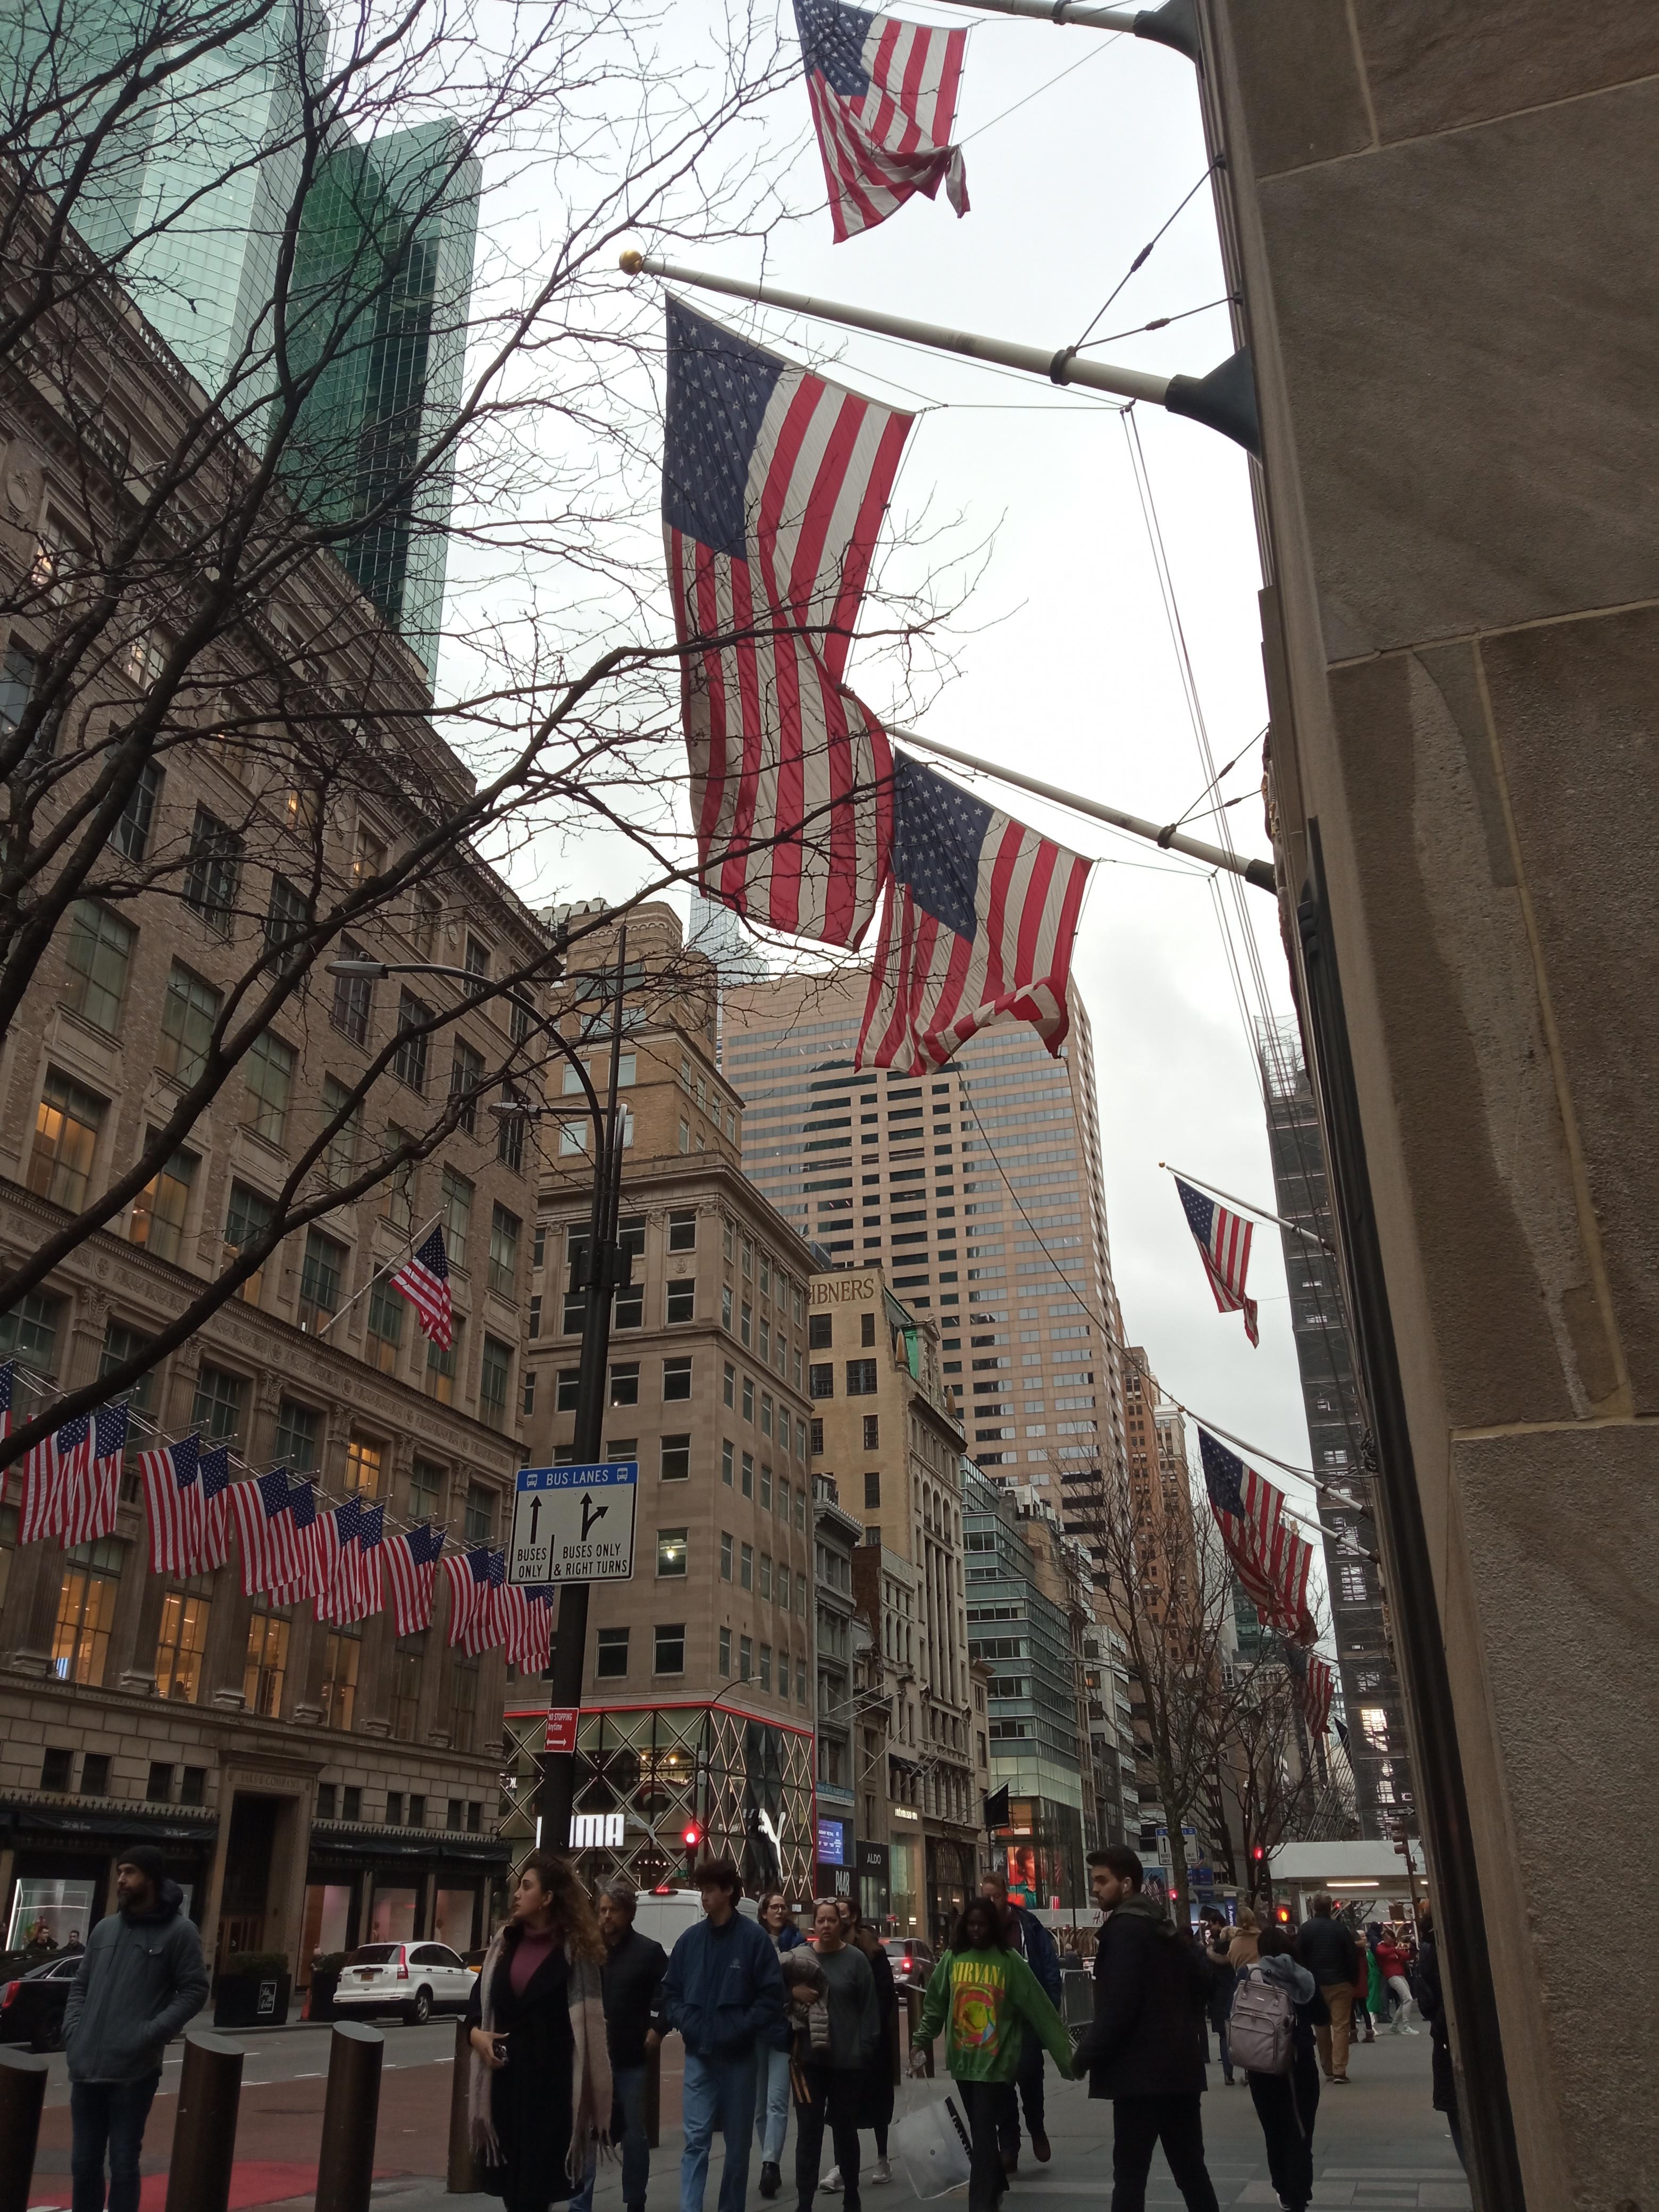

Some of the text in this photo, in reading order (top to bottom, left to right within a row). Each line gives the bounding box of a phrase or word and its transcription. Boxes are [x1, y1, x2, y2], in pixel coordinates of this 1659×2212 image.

[809, 1278, 874, 1304] IBNERS
[546, 1470, 608, 1486] BUS LANES
[517, 1547, 547, 1562] BUSES
[563, 1543, 621, 1559] BUSES ONLY
[518, 1564, 543, 1578] ONLY
[554, 1560, 627, 1577] & RIGHT TURNS
[554, 1713, 573, 1721] STOPPING
[548, 1723, 562, 1732] Anytime
[535, 1814, 624, 1849] MA
[867, 1853, 881, 1865] ALDO
[835, 1870, 850, 1897] P448
[952, 1962, 1005, 1990] NIRVANA
